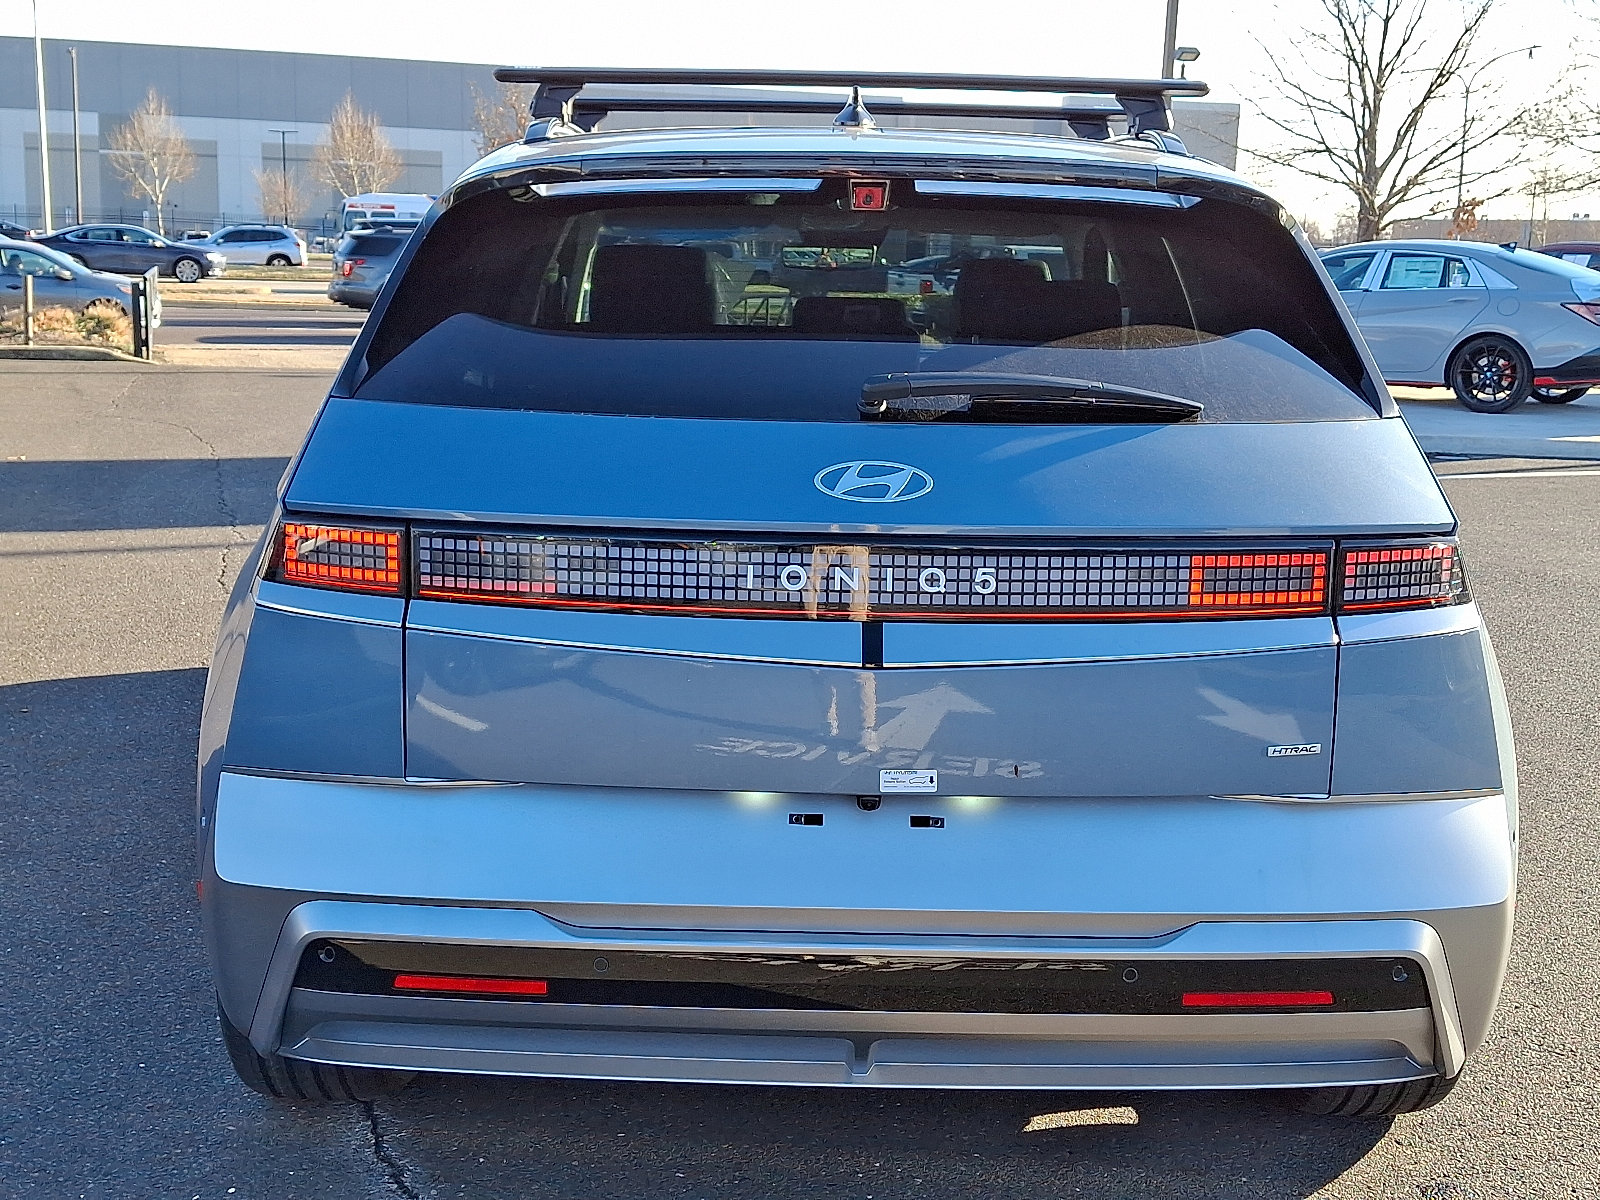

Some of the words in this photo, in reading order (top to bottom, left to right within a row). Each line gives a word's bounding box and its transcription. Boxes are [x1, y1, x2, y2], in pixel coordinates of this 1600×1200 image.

[746, 564, 946, 593] IONIQ
[974, 567, 997, 595] 5
[1272, 745, 1317, 755] HTRAC
